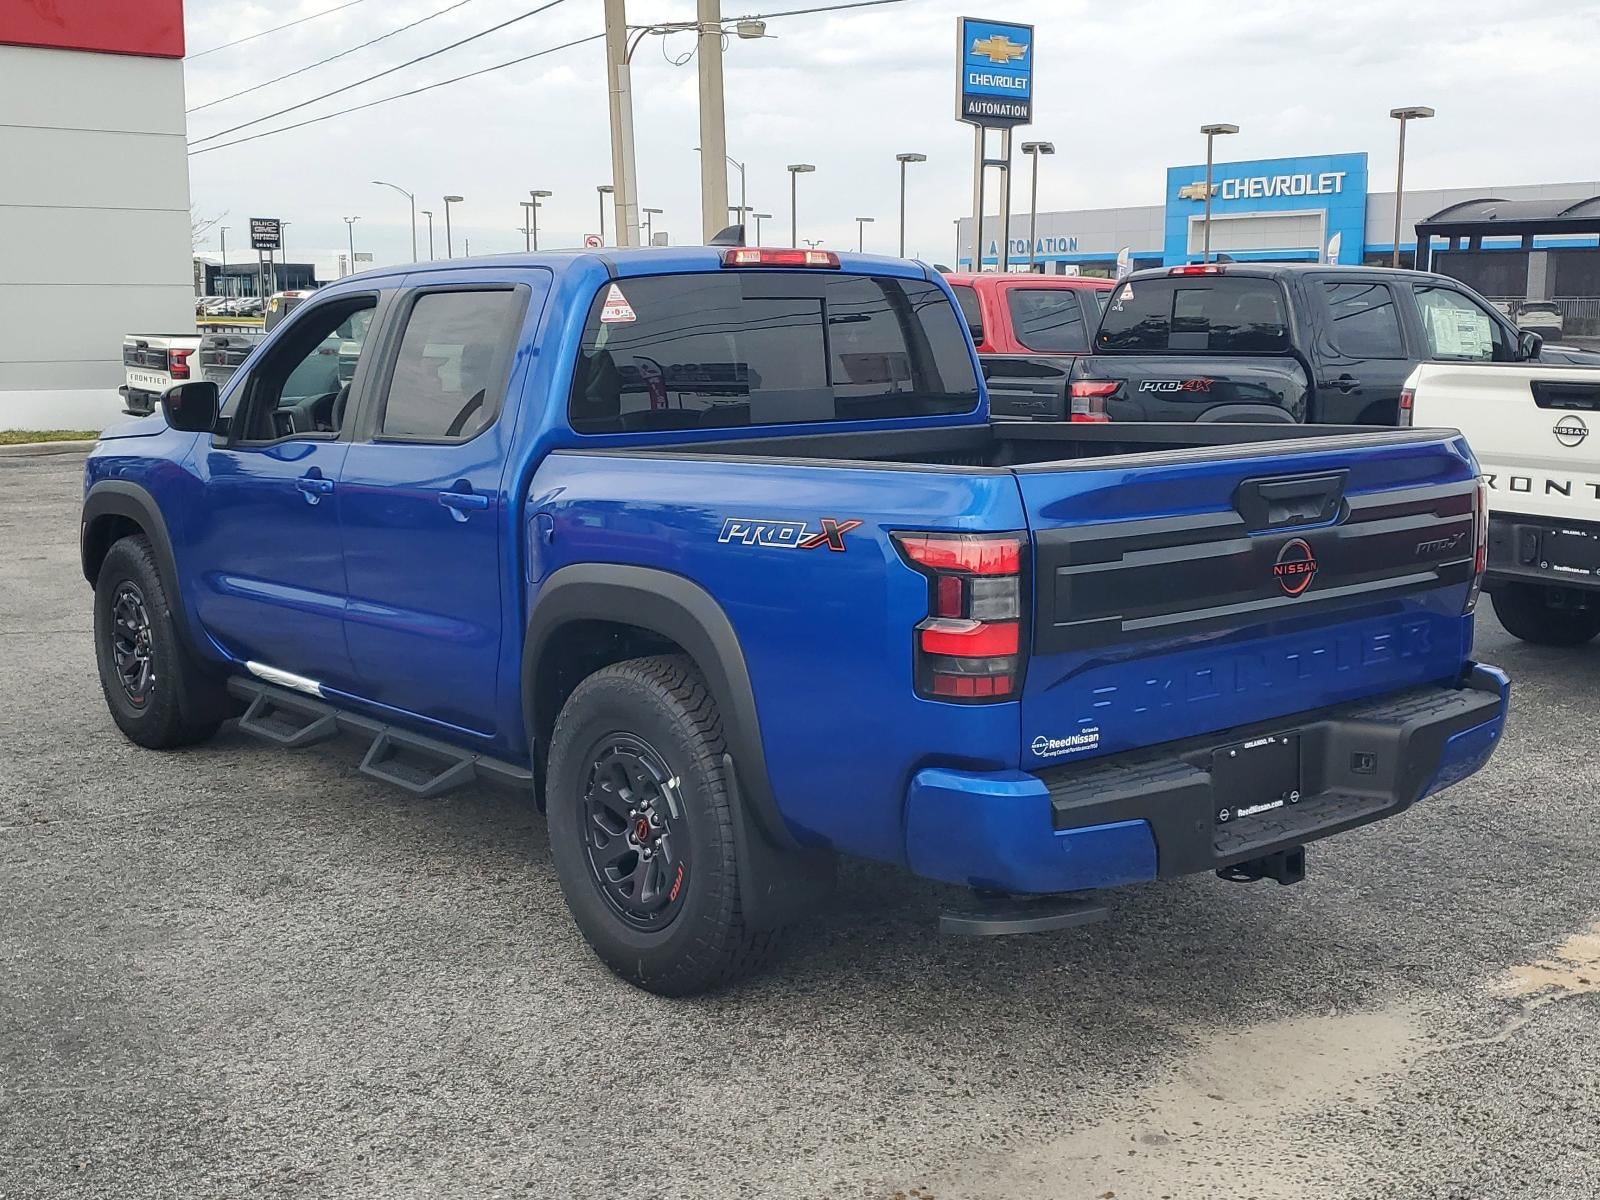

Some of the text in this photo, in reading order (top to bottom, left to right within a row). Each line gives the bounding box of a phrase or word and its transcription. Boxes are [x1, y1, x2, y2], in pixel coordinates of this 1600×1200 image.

[969, 73, 1028, 89] CHEVROLET
[968, 101, 1028, 117] AUTONATION
[1222, 171, 1346, 200] CHEVROLET
[989, 237, 1079, 255] ATONATION
[1138, 378, 1215, 393] PRO-4X
[1552, 426, 1589, 437] NISSAN
[1482, 473, 1600, 499] RONT
[716, 517, 865, 553] PRO-X
[1273, 560, 1317, 576] NISSAN
[1077, 619, 1432, 724] FRONTIER
[1243, 738, 1268, 749] ORLANDO,
[1237, 800, 1283, 817] ReedNissan.com
